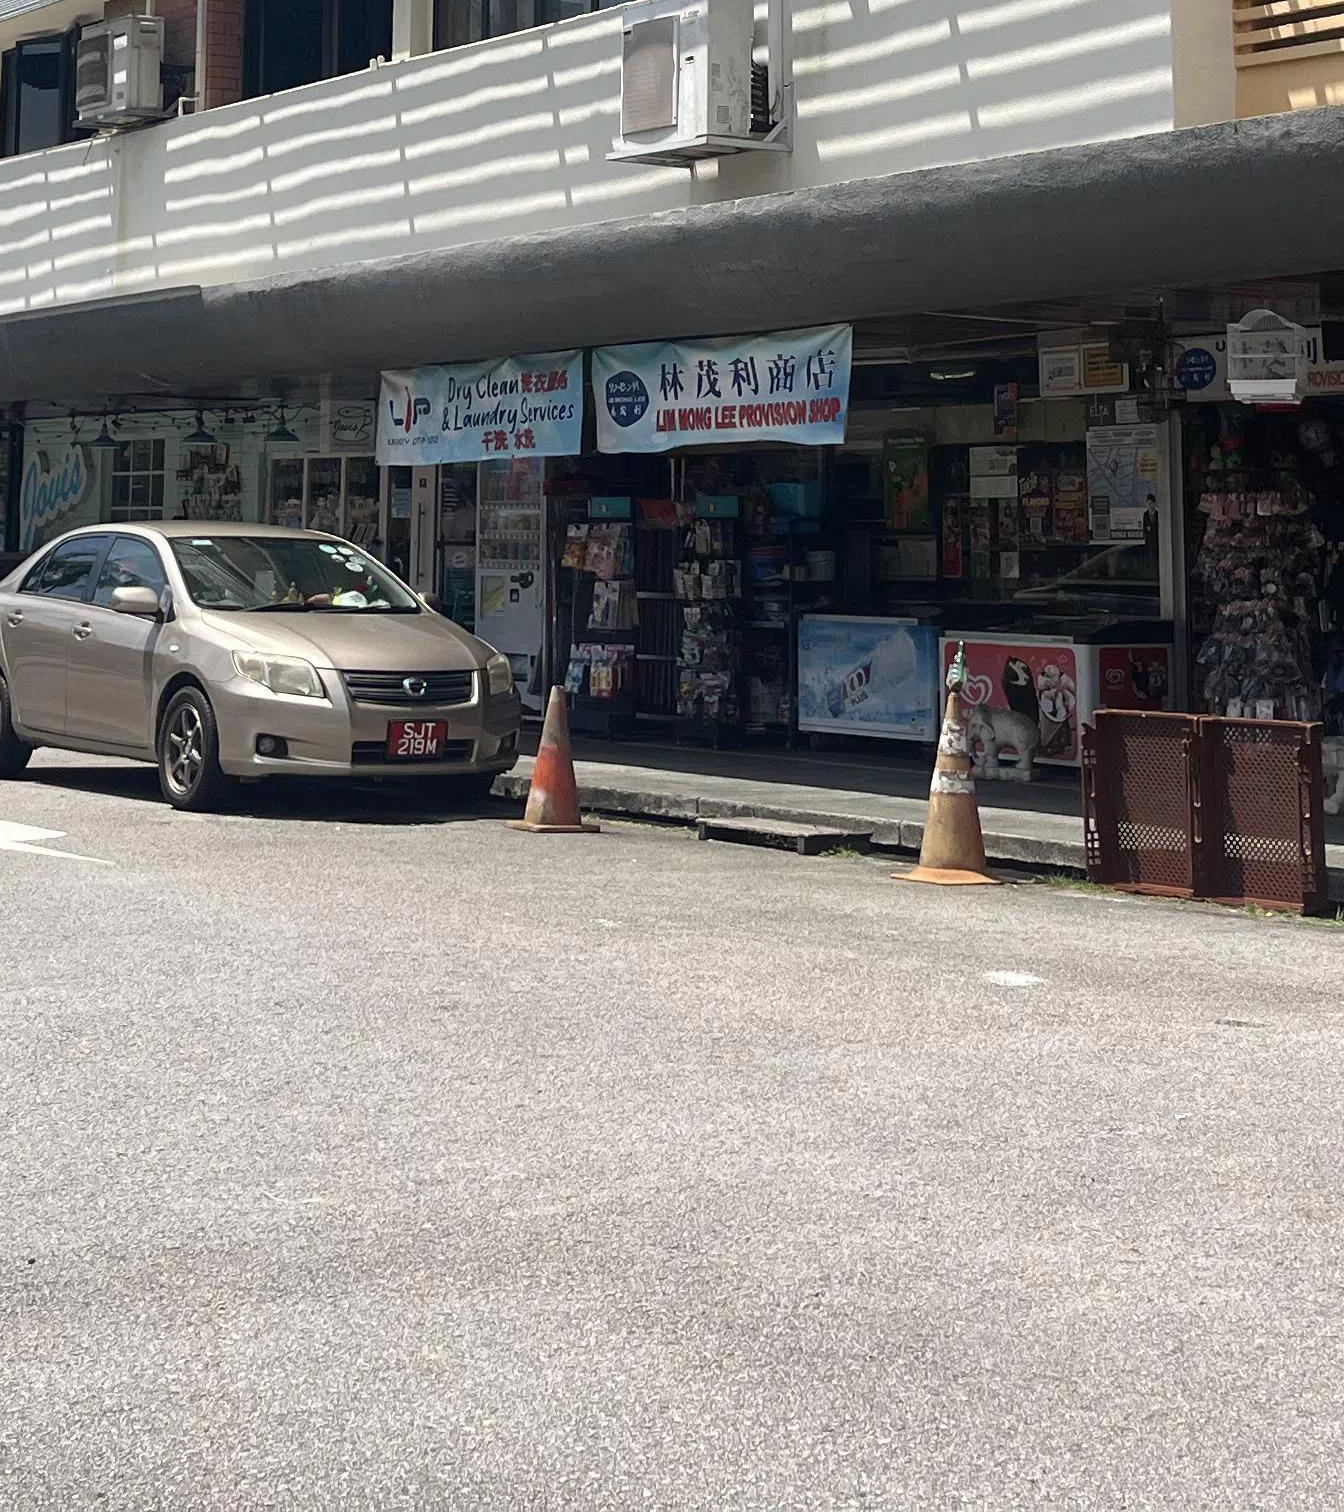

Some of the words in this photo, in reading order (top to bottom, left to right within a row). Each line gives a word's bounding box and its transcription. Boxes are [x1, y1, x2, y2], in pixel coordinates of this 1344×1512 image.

[447, 376, 472, 409] Dry
[476, 373, 519, 399] Clean
[659, 349, 836, 402] 林茂利商店
[441, 406, 451, 432] &
[454, 400, 518, 434] Laundry
[520, 397, 575, 425] Services
[657, 407, 677, 432] LIM
[679, 406, 712, 432] MONG
[714, 405, 737, 429] LEE
[739, 399, 806, 428] PROVISION
[809, 397, 841, 424] SHOP
[397, 738, 438, 755] 219M
[403, 722, 436, 739] SJT
